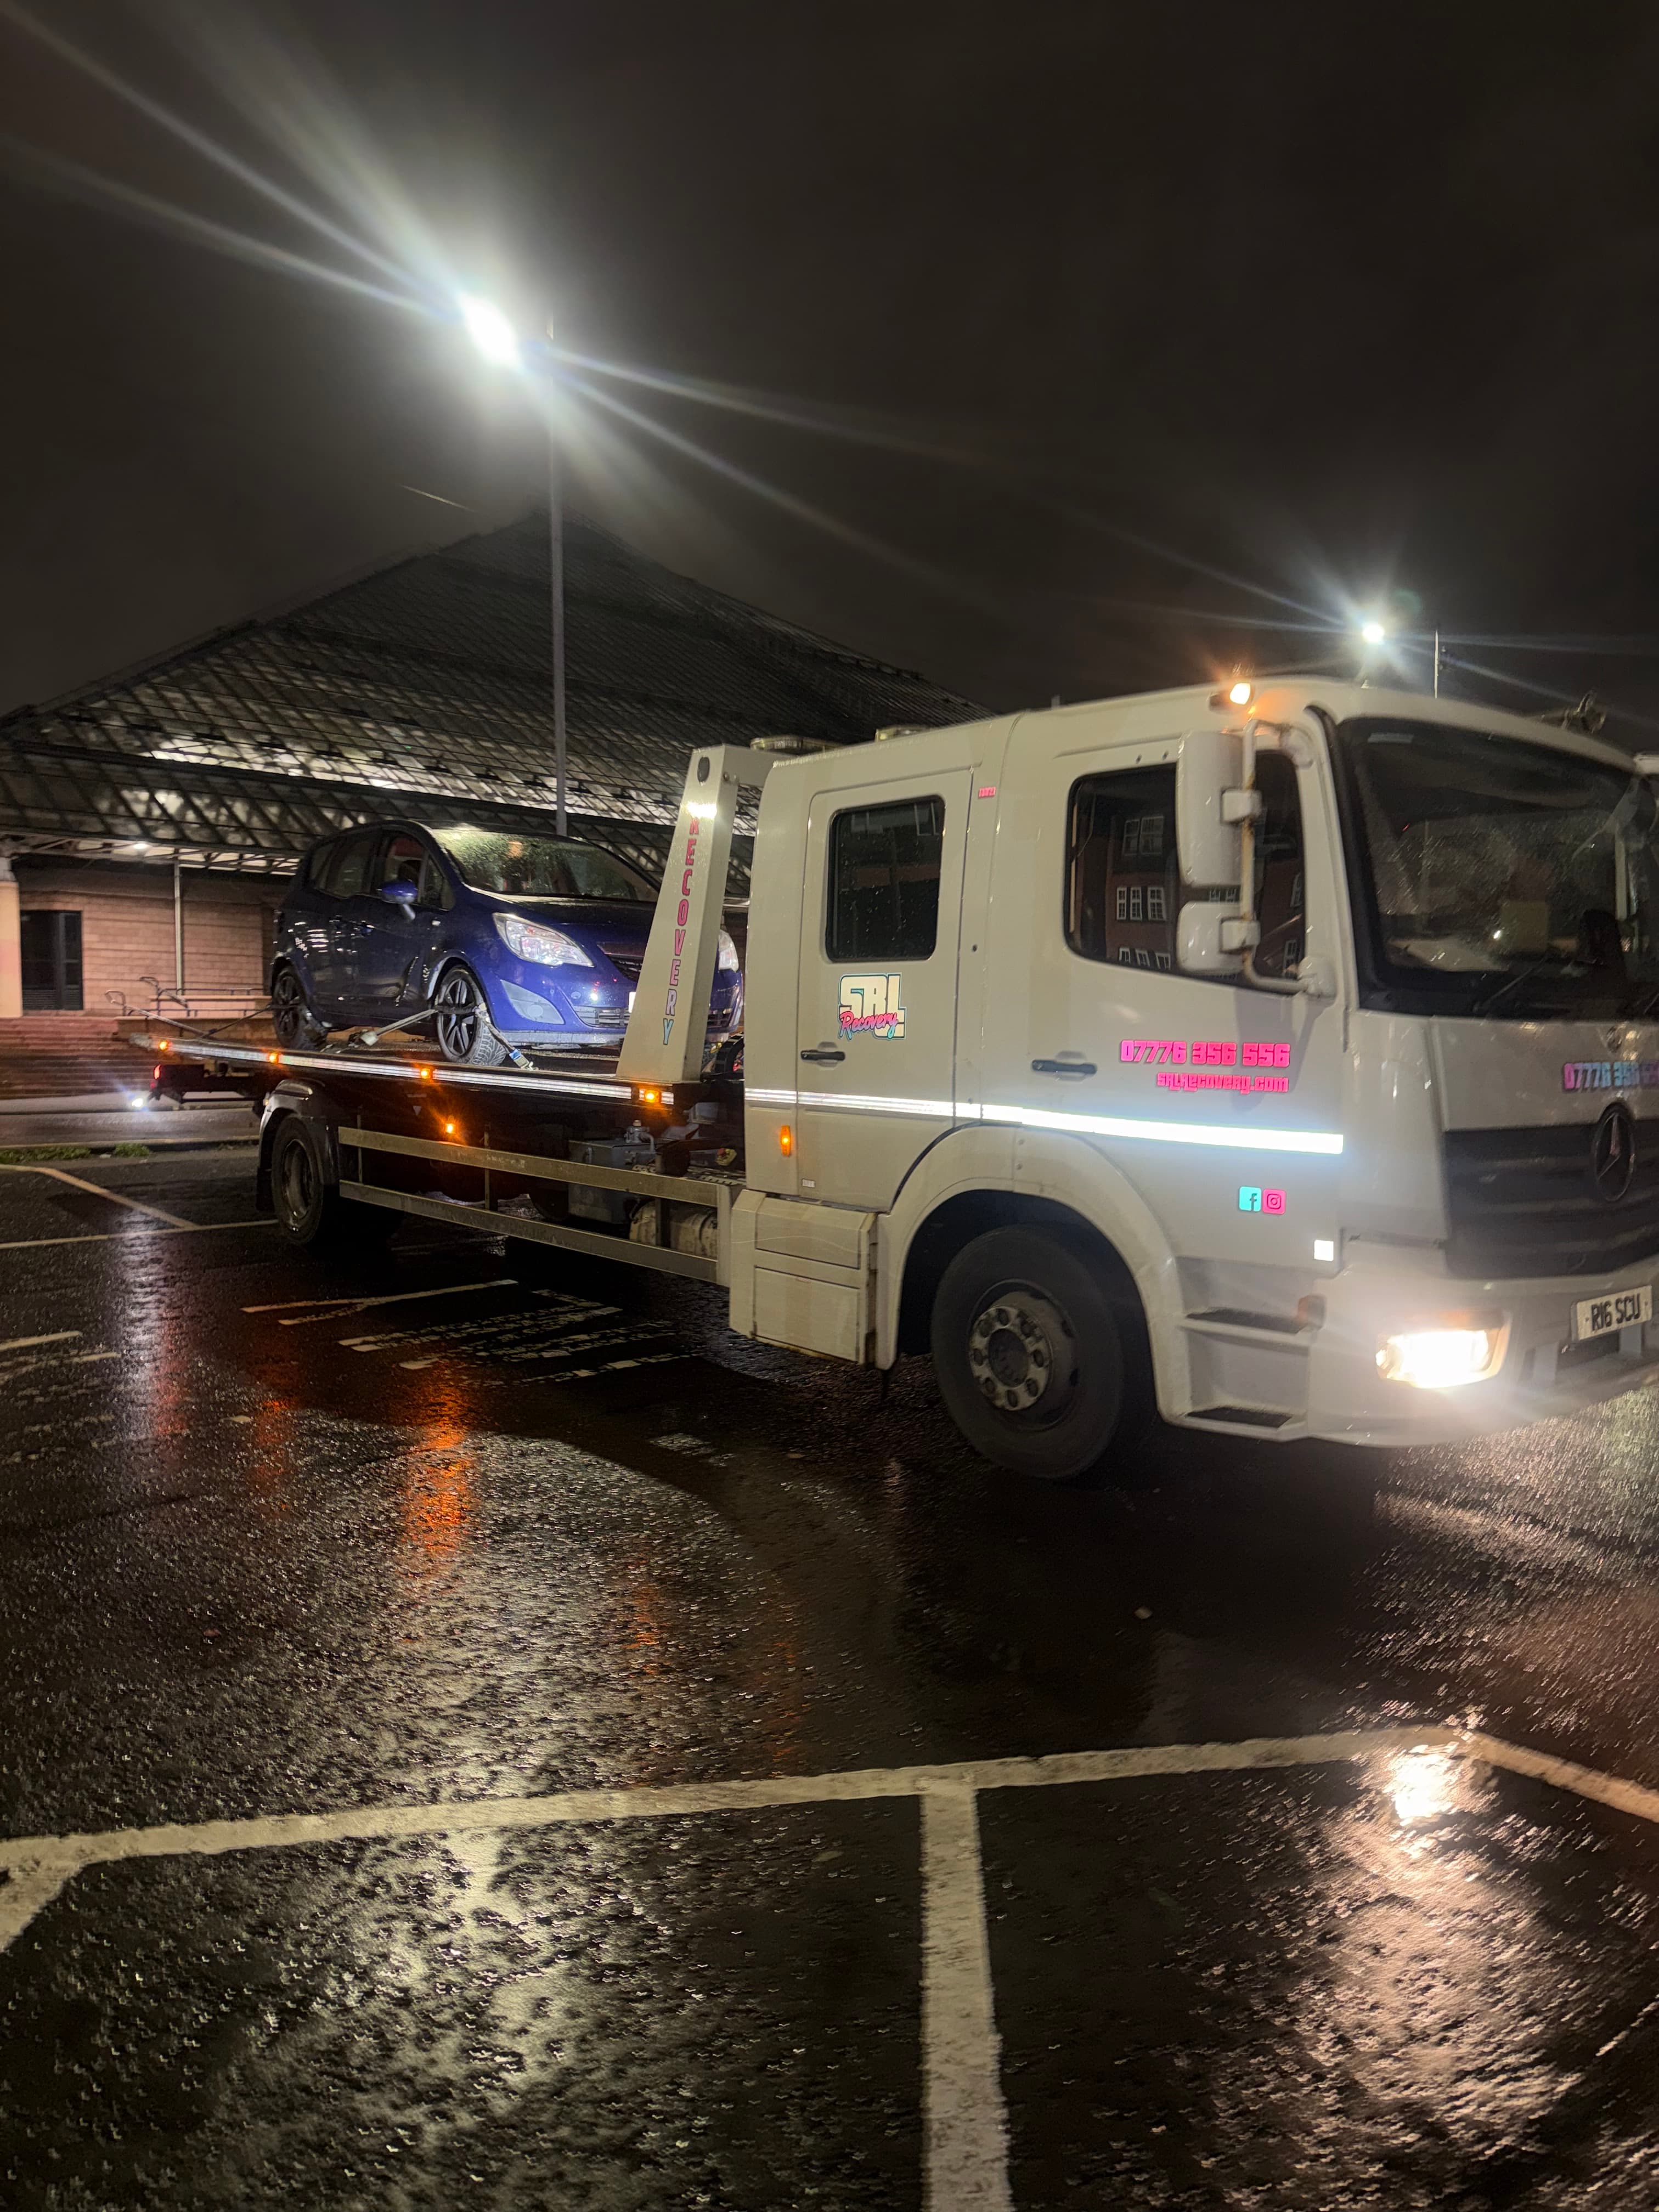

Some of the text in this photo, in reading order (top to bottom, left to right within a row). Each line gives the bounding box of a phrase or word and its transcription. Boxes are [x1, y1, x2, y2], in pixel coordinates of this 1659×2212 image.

[663, 816, 699, 1045] RECOVERY
[839, 973, 906, 1039] SRL
[838, 1011, 898, 1040] Recovery
[1121, 1040, 1290, 1067] 07776 356 556
[1564, 1062, 1611, 1089] 07776
[1592, 1293, 1640, 1331] R16 SCU
